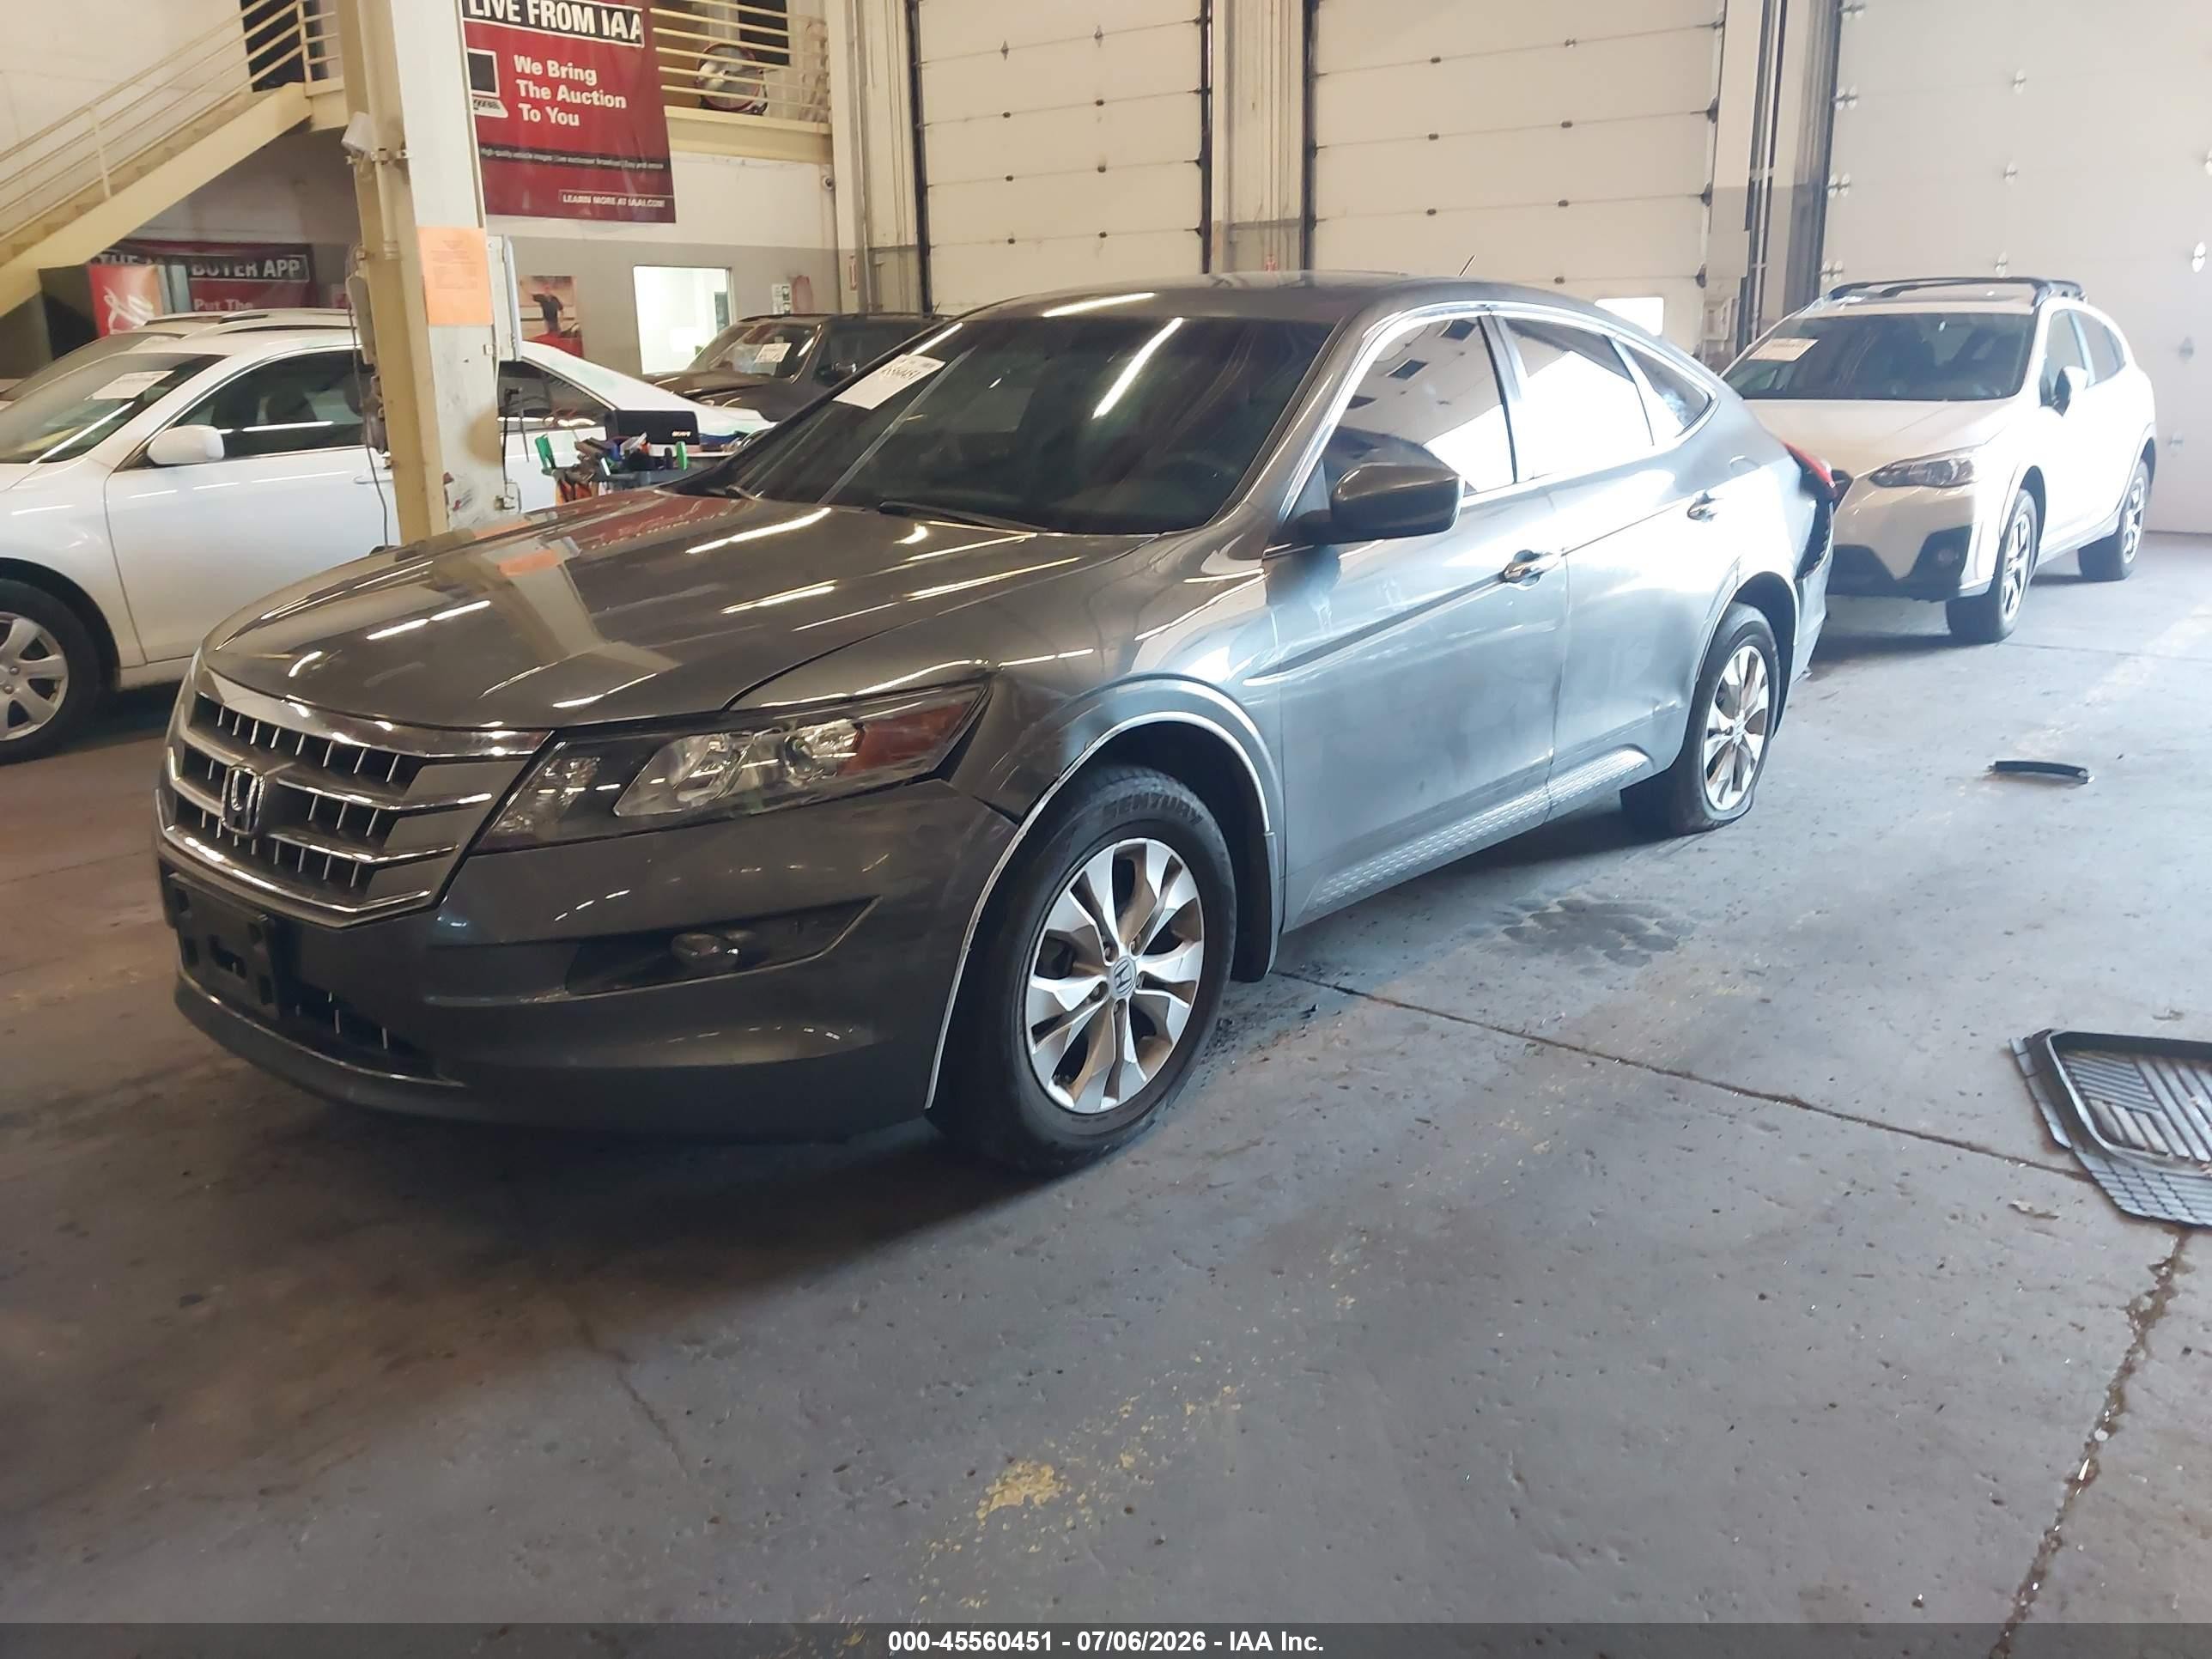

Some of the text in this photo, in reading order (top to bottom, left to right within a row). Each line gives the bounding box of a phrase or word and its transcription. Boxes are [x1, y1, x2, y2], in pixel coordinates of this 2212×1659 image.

[470, 0, 522, 22] LIVE
[527, 0, 596, 34] FROM
[514, 54, 597, 86] We Bring
[515, 79, 627, 109] The Auction
[517, 103, 580, 126] To You
[263, 259, 301, 277] APP
[194, 299, 253, 312] Put The
